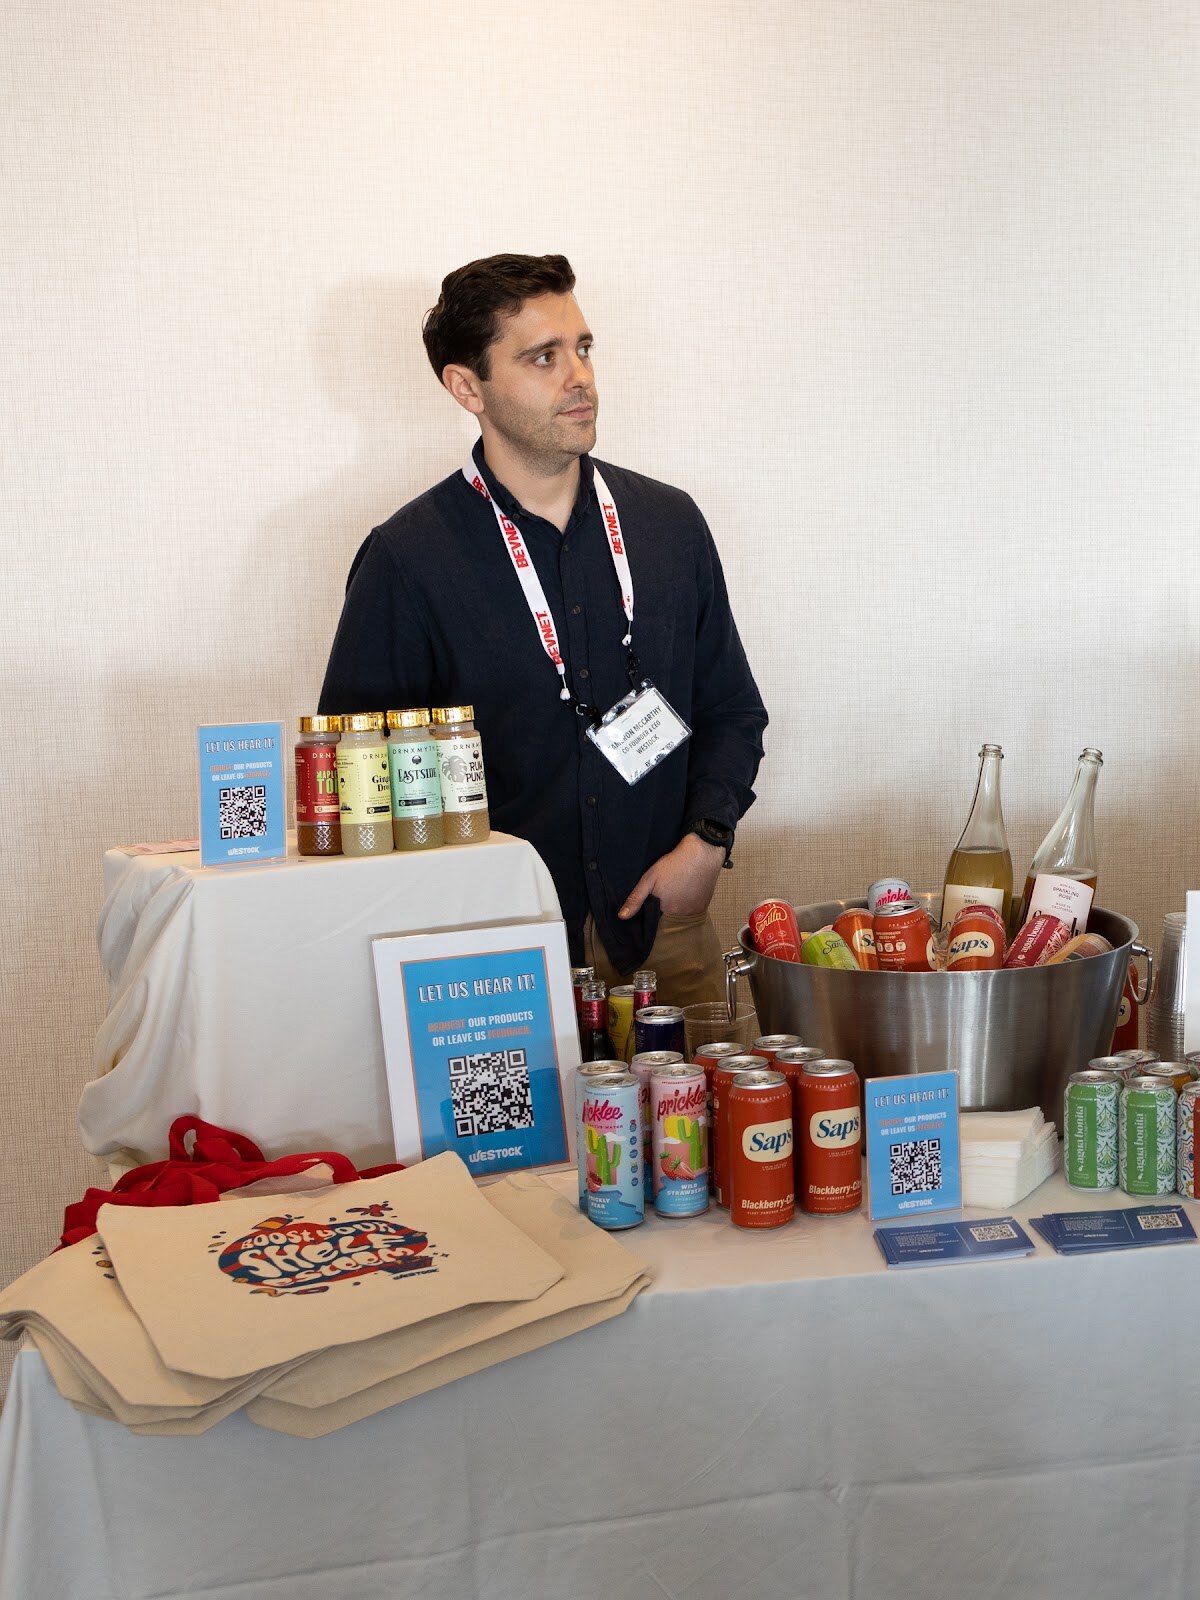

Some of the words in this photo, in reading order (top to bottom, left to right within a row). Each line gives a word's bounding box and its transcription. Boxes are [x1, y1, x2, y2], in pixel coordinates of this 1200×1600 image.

[602, 502, 624, 555] BEVNET
[499, 514, 529, 569] BEVNET
[535, 610, 564, 665] BEVNET
[633, 705, 662, 732] MCCARTHY
[205, 741, 221, 753] LET
[223, 740, 235, 752] US
[238, 738, 261, 751] HEAR
[621, 729, 650, 754] CO-FOUNDER
[651, 719, 661, 731] CEO
[636, 733, 660, 755] WESTOCK
[245, 761, 272, 769] PRODUCTS
[397, 767, 437, 785] EASTSIDE
[221, 773, 236, 781] LEAVE
[1052, 886, 1080, 898] SPARKLING
[418, 984, 443, 1003] LET
[448, 981, 469, 999] US
[473, 976, 513, 996] HEAR
[517, 973, 536, 991] IT!
[467, 1017, 487, 1028] OUR
[488, 1011, 534, 1025] PRODUCTS
[432, 1036, 446, 1047] OR
[447, 1032, 473, 1045] LEAVE
[474, 1031, 487, 1041] US
[874, 1096, 890, 1108] LET
[893, 1094, 906, 1105] US
[909, 1090, 935, 1104] HEAR
[938, 1088, 950, 1099] IT!
[816, 1116, 860, 1140] Sap's
[917, 1111, 947, 1122] PRODUCTS
[1074, 1105, 1084, 1138] bonita
[880, 1128, 890, 1136] OR
[890, 1126, 907, 1135] LEAVE
[907, 1125, 915, 1133] US
[1133, 1113, 1144, 1145] bonita
[749, 1128, 792, 1154] Sap's
[1077, 1140, 1086, 1164] agua
[469, 1145, 524, 1163] WESTOCK
[1136, 1146, 1145, 1172] agua
